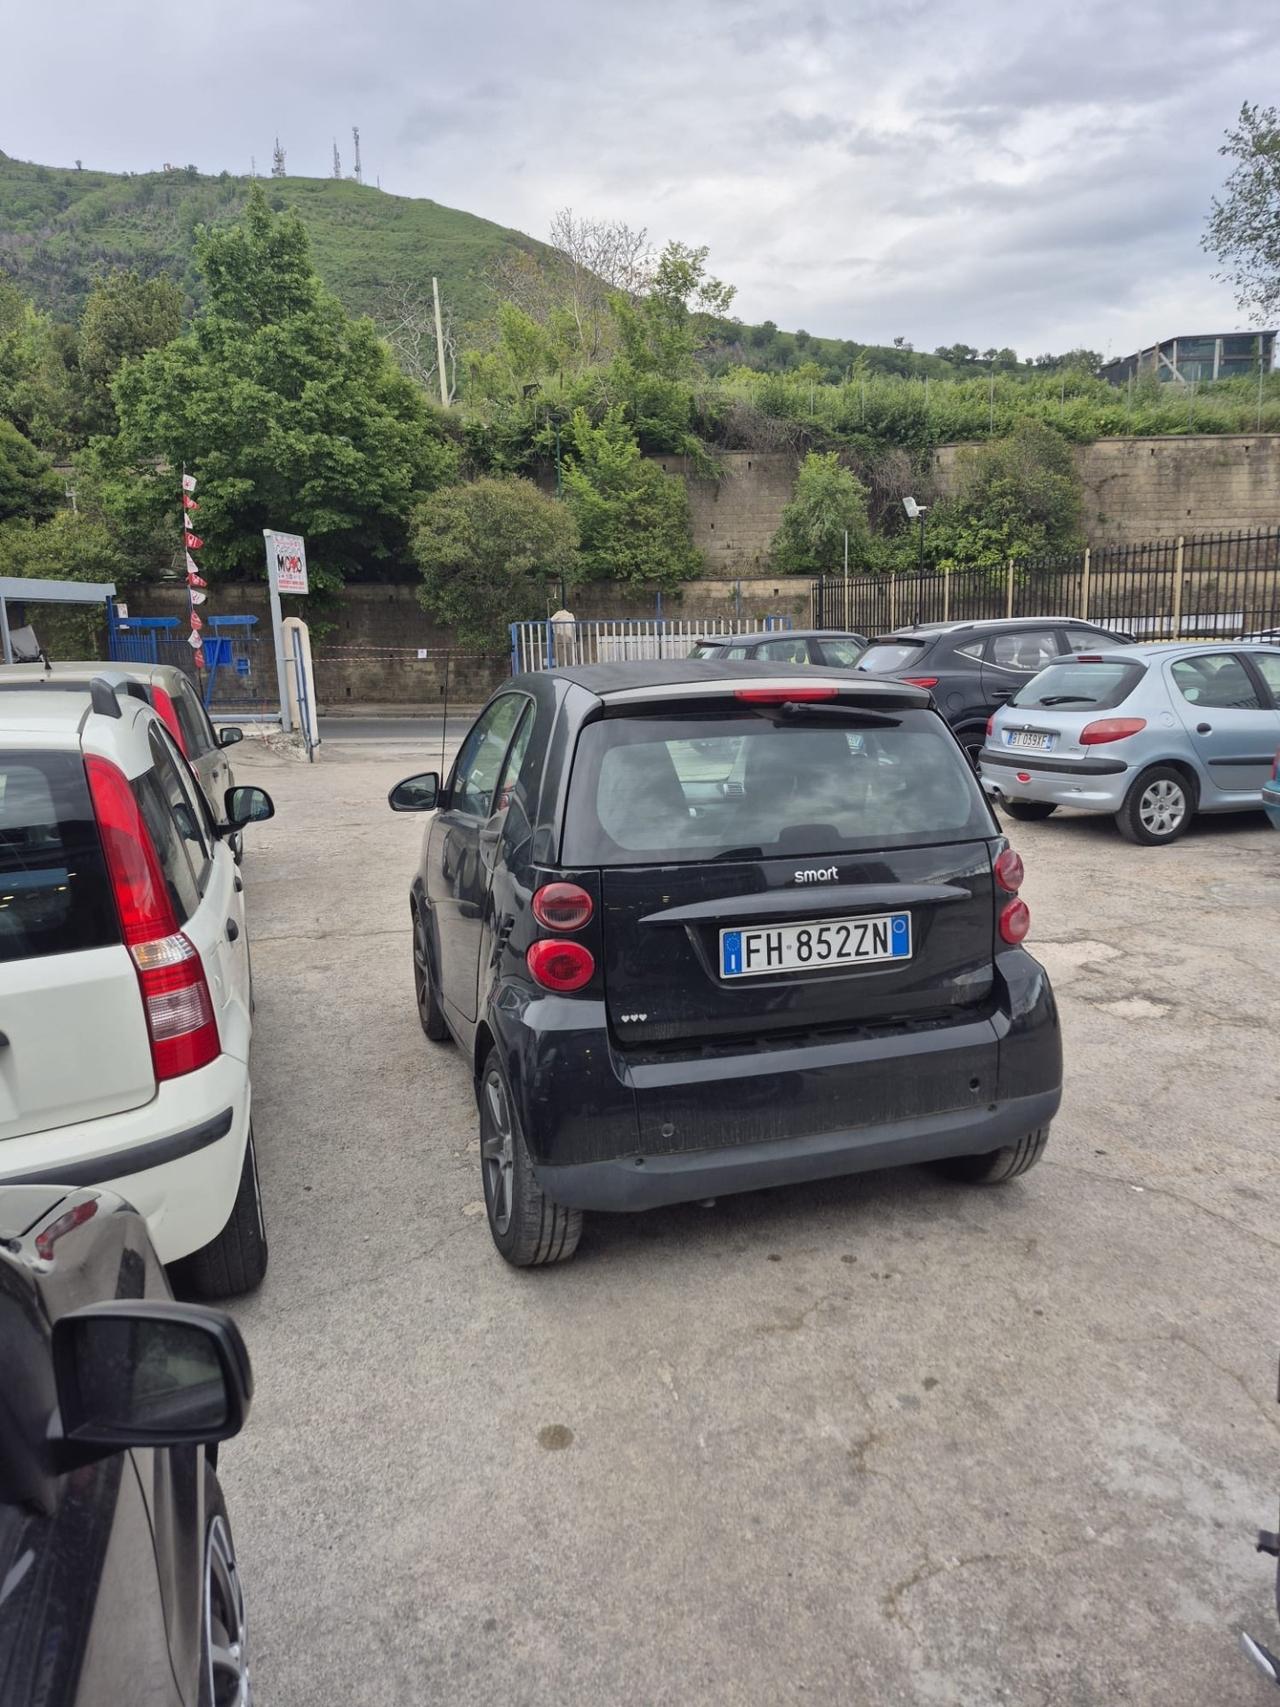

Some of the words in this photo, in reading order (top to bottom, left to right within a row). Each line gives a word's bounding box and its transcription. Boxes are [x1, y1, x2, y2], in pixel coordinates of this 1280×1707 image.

[794, 865, 839, 883] smart
[746, 931, 783, 968] FH
[796, 921, 889, 962] 852ZN
